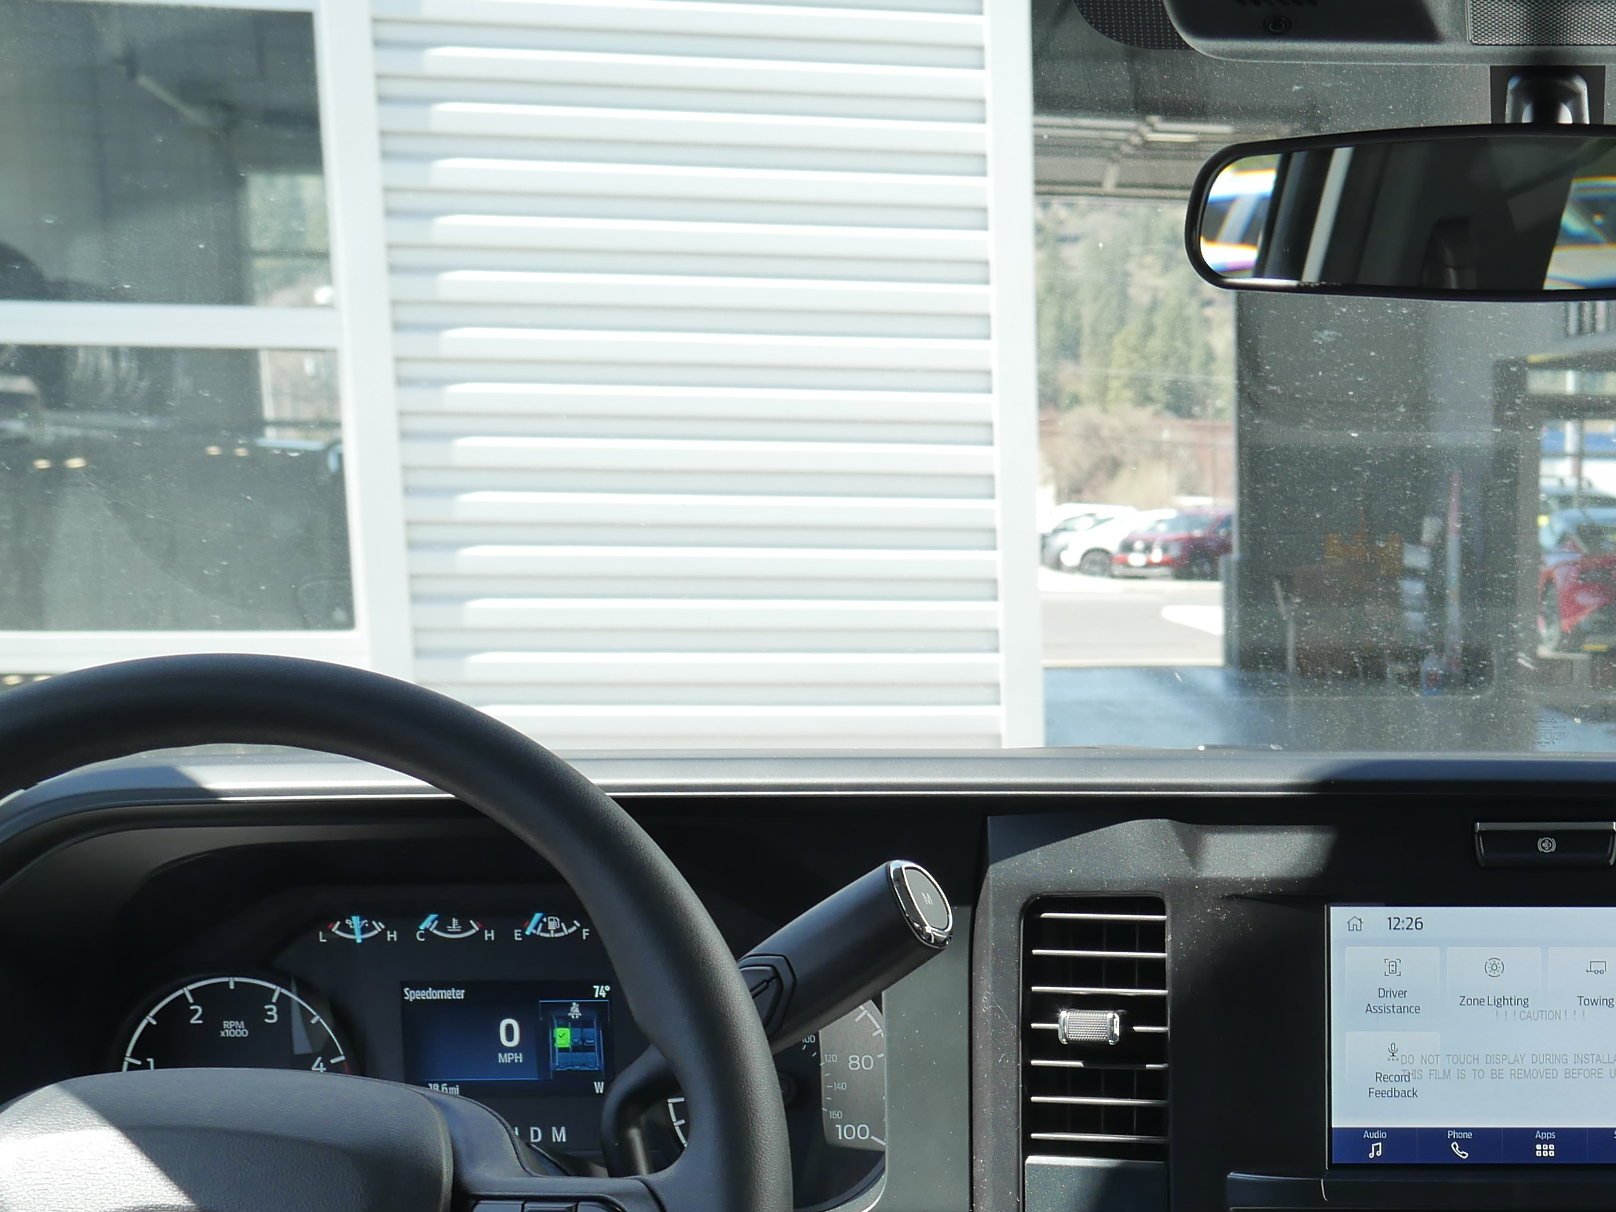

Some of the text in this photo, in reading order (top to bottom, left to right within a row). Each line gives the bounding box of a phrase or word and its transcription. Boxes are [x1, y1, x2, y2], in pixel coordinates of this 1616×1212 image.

[1386, 916, 1424, 931] 12:26
[318, 931, 327, 942] L
[386, 930, 398, 942] H
[416, 930, 426, 942] C
[484, 929, 495, 941] H
[514, 929, 523, 941] E
[582, 928, 590, 940] F
[403, 987, 465, 1001] Speedometer
[593, 985, 611, 998] 74°
[1377, 987, 1408, 999] Driver
[1459, 995, 1529, 1008] Zone Lighting
[1577, 996, 1615, 1008] Towing
[189, 1005, 204, 1024] 2
[264, 1005, 278, 1023] 3
[1365, 1003, 1421, 1014] Assistance
[223, 1020, 245, 1029] RPM
[220, 1029, 249, 1038] x1000
[499, 1018, 520, 1048] 0
[498, 1053, 523, 1063] MPH
[824, 1054, 838, 1063] 120
[848, 1055, 874, 1071] 80
[1401, 1054, 1415, 1065] DO
[1420, 1054, 1440, 1065] NOT
[1446, 1054, 1480, 1065] TOUCH
[1485, 1054, 1525, 1065] DISPLAY
[1531, 1053, 1568, 1064] DURING
[311, 1056, 327, 1073] 4
[1375, 1072, 1411, 1083] Record
[1429, 1069, 1451, 1079] FILM
[1456, 1069, 1466, 1079] IS
[1472, 1069, 1485, 1079] TO
[1490, 1069, 1504, 1079] BE
[1510, 1068, 1558, 1079] REMOVED
[1564, 1068, 1604, 1079] BEFORE
[594, 1082, 605, 1093] W
[833, 1082, 847, 1091] 140
[1368, 1087, 1418, 1098] Feedback
[828, 1110, 843, 1119] 160
[529, 1127, 542, 1143] D
[551, 1126, 567, 1143] M
[835, 1124, 870, 1140] 100
[1363, 1130, 1387, 1139] Audio
[1447, 1130, 1473, 1139] Phone
[1535, 1130, 1556, 1140] Apps
